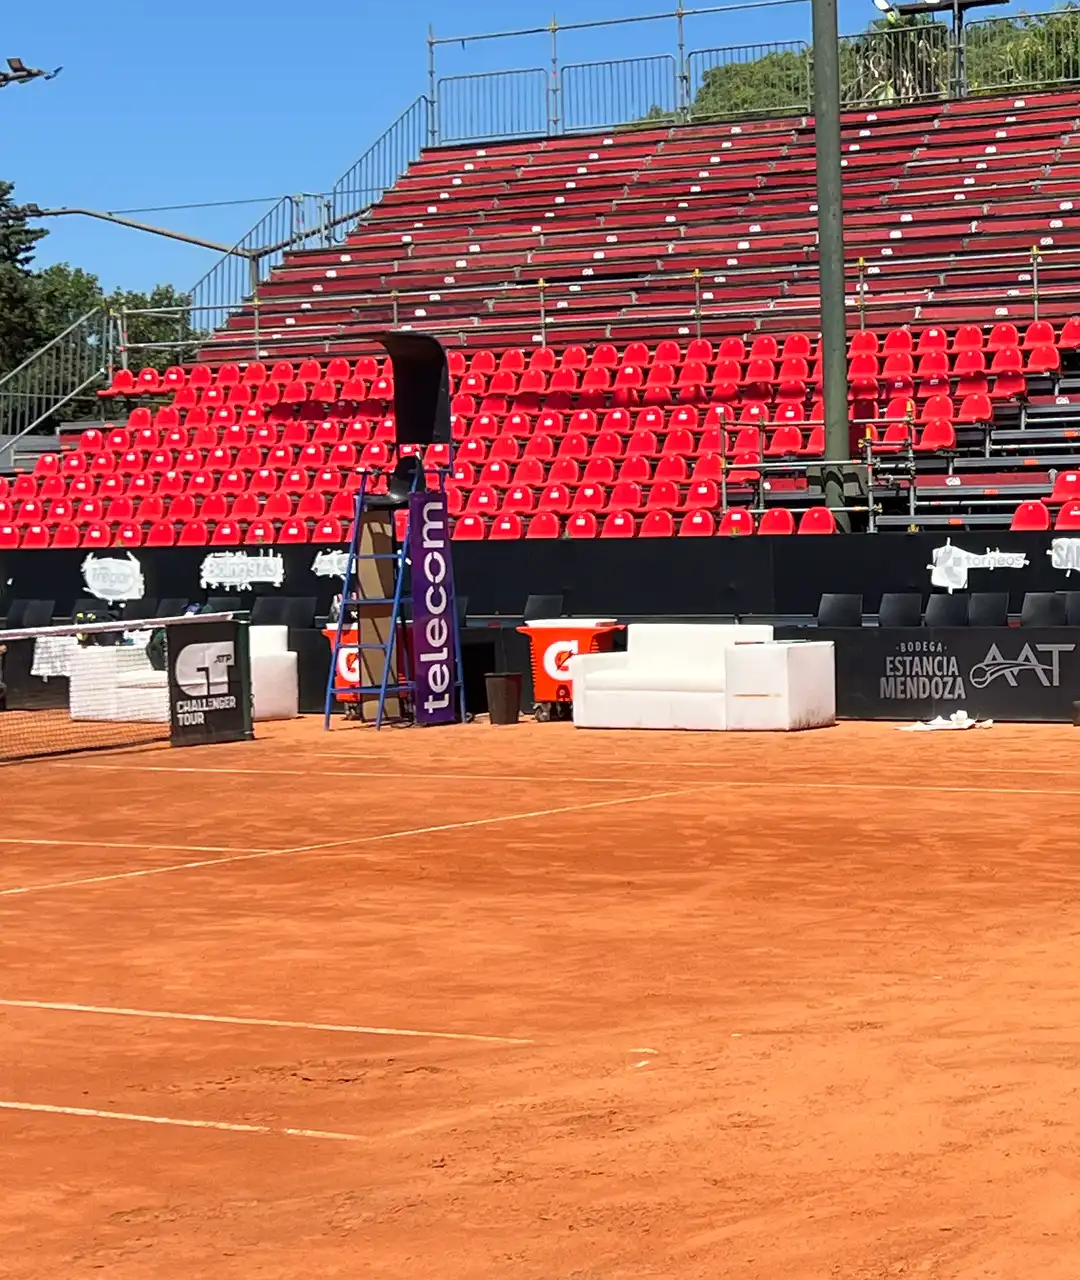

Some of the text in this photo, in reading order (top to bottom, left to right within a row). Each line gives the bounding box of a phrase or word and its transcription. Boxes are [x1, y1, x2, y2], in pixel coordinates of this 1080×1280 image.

[965, 554, 1024, 568] torneos
[419, 500, 450, 714] telecom
[900, 641, 943, 653] BODEGA
[214, 653, 233, 664] ATP
[885, 656, 960, 676] ESTANCIA
[879, 676, 967, 700] MENDOZA
[175, 695, 237, 714] CHALLENGER
[176, 711, 205, 727] TOUR
